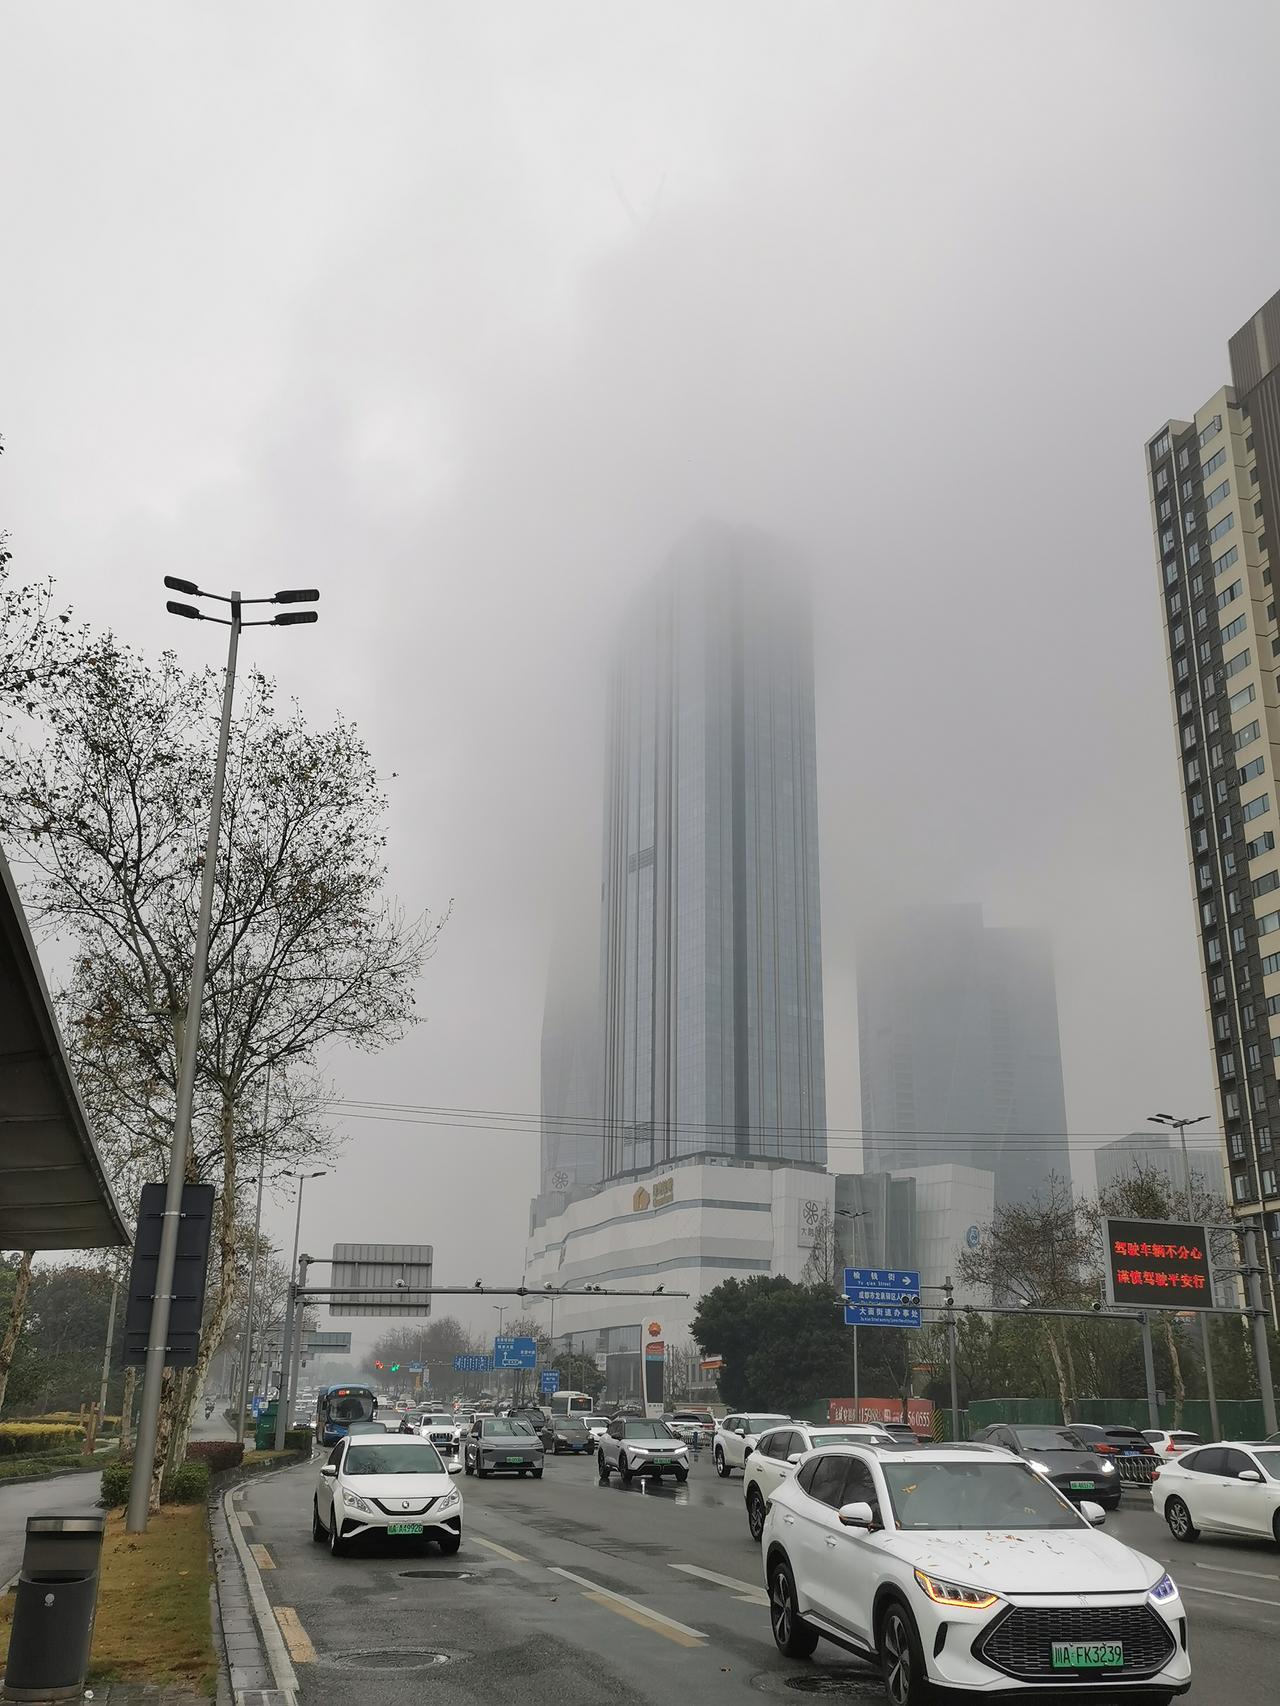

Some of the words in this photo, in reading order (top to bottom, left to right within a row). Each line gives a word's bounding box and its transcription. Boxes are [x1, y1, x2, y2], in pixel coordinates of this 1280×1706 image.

[1114, 1240, 1202, 1260] 驾驶车辆不分心
[853, 1271, 895, 1281] 榆钱街
[1117, 1269, 1206, 1288] 谨慎驾驶平安行
[859, 1307, 919, 1318] 大面街道办事处
